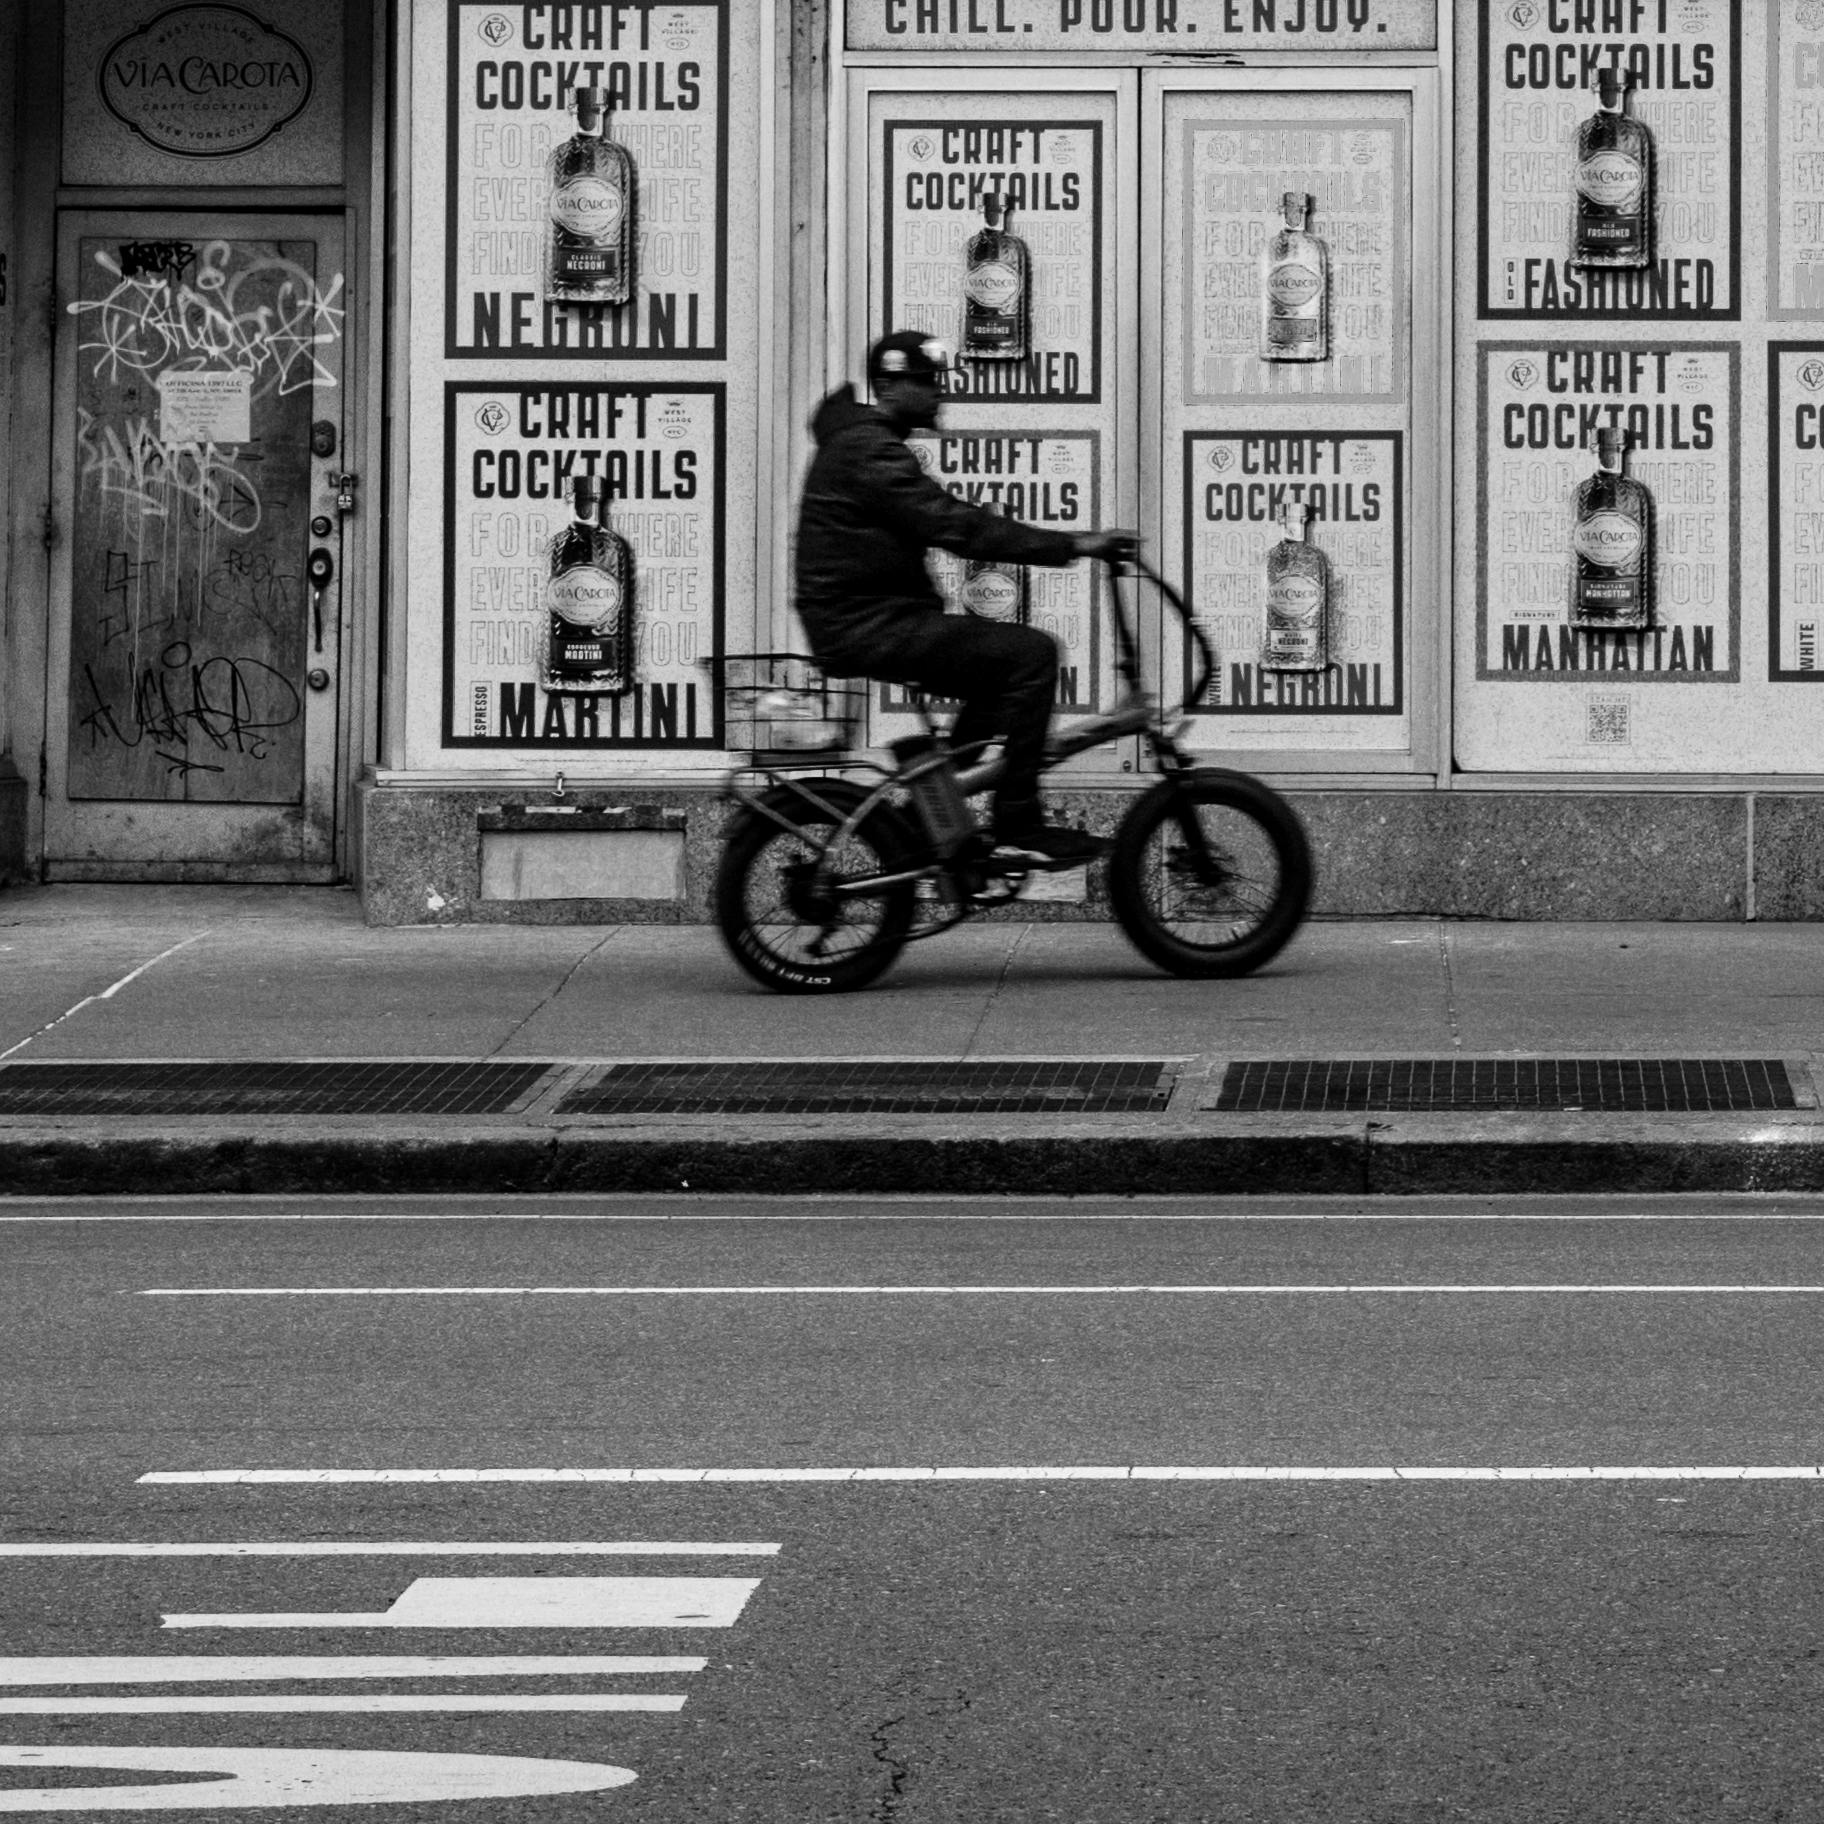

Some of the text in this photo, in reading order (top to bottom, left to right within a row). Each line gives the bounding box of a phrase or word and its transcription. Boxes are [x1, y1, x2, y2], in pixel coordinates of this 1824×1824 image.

[522, 5, 654, 50] CRAFT
[114, 56, 300, 94] VIA CAROTA
[1505, 44, 1714, 89] COCKTAILS
[476, 62, 700, 110] COCKTAILS
[143, 103, 269, 111] CRAFT COCKTAILS
[158, 122, 181, 137] NEW
[228, 123, 255, 137] CITY
[1241, 440, 1344, 475] CRAFT
[1205, 483, 1380, 521] COCKTAILS
[1800, 623, 1816, 670] WHITE
